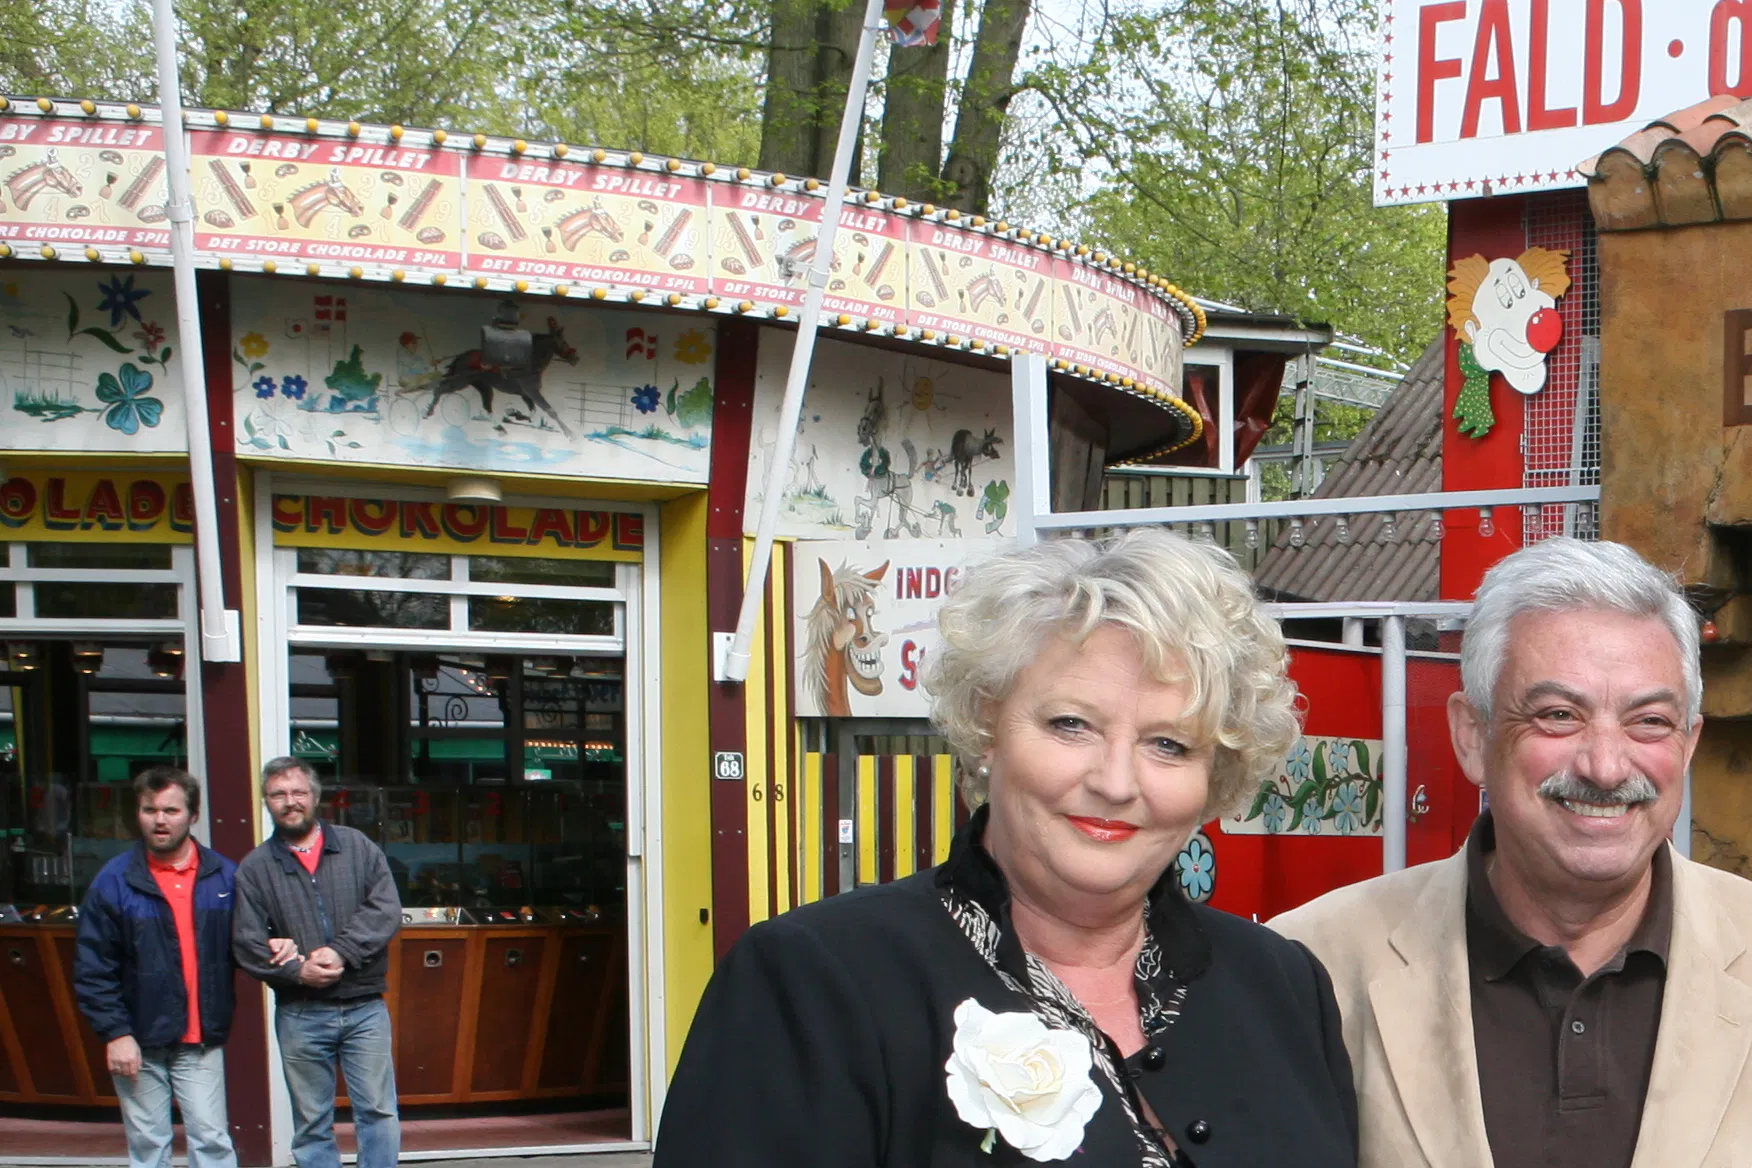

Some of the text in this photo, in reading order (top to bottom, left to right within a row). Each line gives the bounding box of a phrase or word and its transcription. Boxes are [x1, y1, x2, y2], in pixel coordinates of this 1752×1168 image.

[1416, 0, 1643, 144] FALD
[47, 126, 152, 147] SPILLET
[227, 136, 432, 171] DERBY SPILLET
[500, 163, 682, 200] DERBY SPILLET
[741, 193, 888, 233] DERBY SILLET
[26, 226, 128, 242] CHOKOLADE
[133, 231, 170, 244] SPIL
[207, 236, 448, 266] DET STORE CHOKOLADE SPIL
[932, 229, 1041, 270] DERBY SPILLET
[481, 257, 697, 291] DET STORE CHOKOLADE SPIL
[723, 282, 897, 321] DET STORE CKOLADE SPIL
[917, 314, 1045, 352] DET STORE CHOKOLADE SPIL
[271, 492, 644, 551] CHOKOLADE
[720, 760, 740, 777] 68
